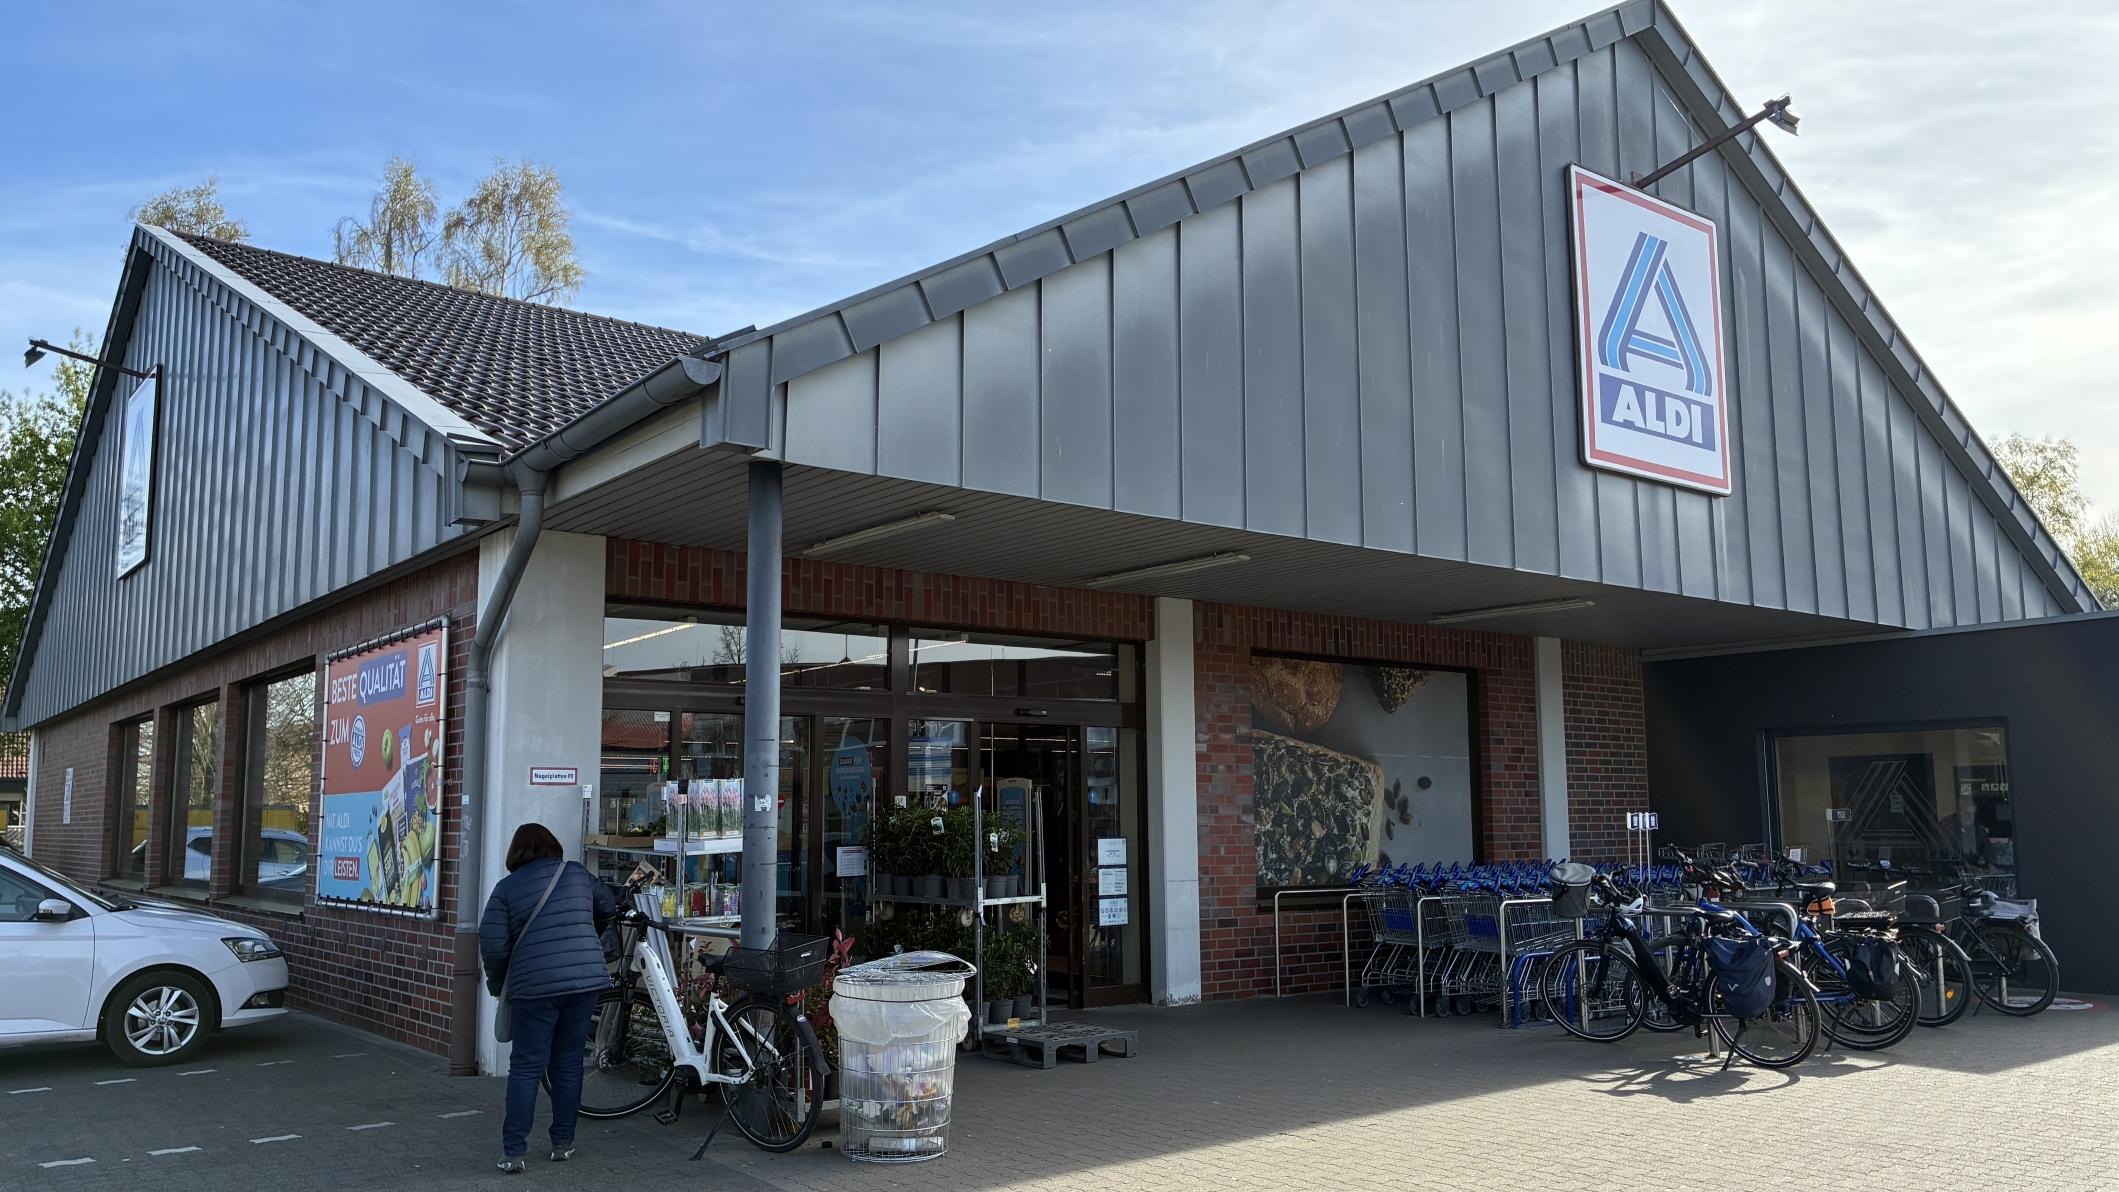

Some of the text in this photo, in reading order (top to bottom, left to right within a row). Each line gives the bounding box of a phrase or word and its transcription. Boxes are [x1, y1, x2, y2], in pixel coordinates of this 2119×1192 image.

[1611, 383, 1703, 444] ALDI
[331, 653, 406, 705] BESTE QUALITÄT
[420, 687, 433, 700] ALDI
[330, 717, 350, 745] ZUM
[337, 812, 351, 829] ALDI
[325, 835, 348, 853] KANNST
[335, 859, 359, 878] LEISTEN.
[646, 975, 675, 1038] VICTORIA
